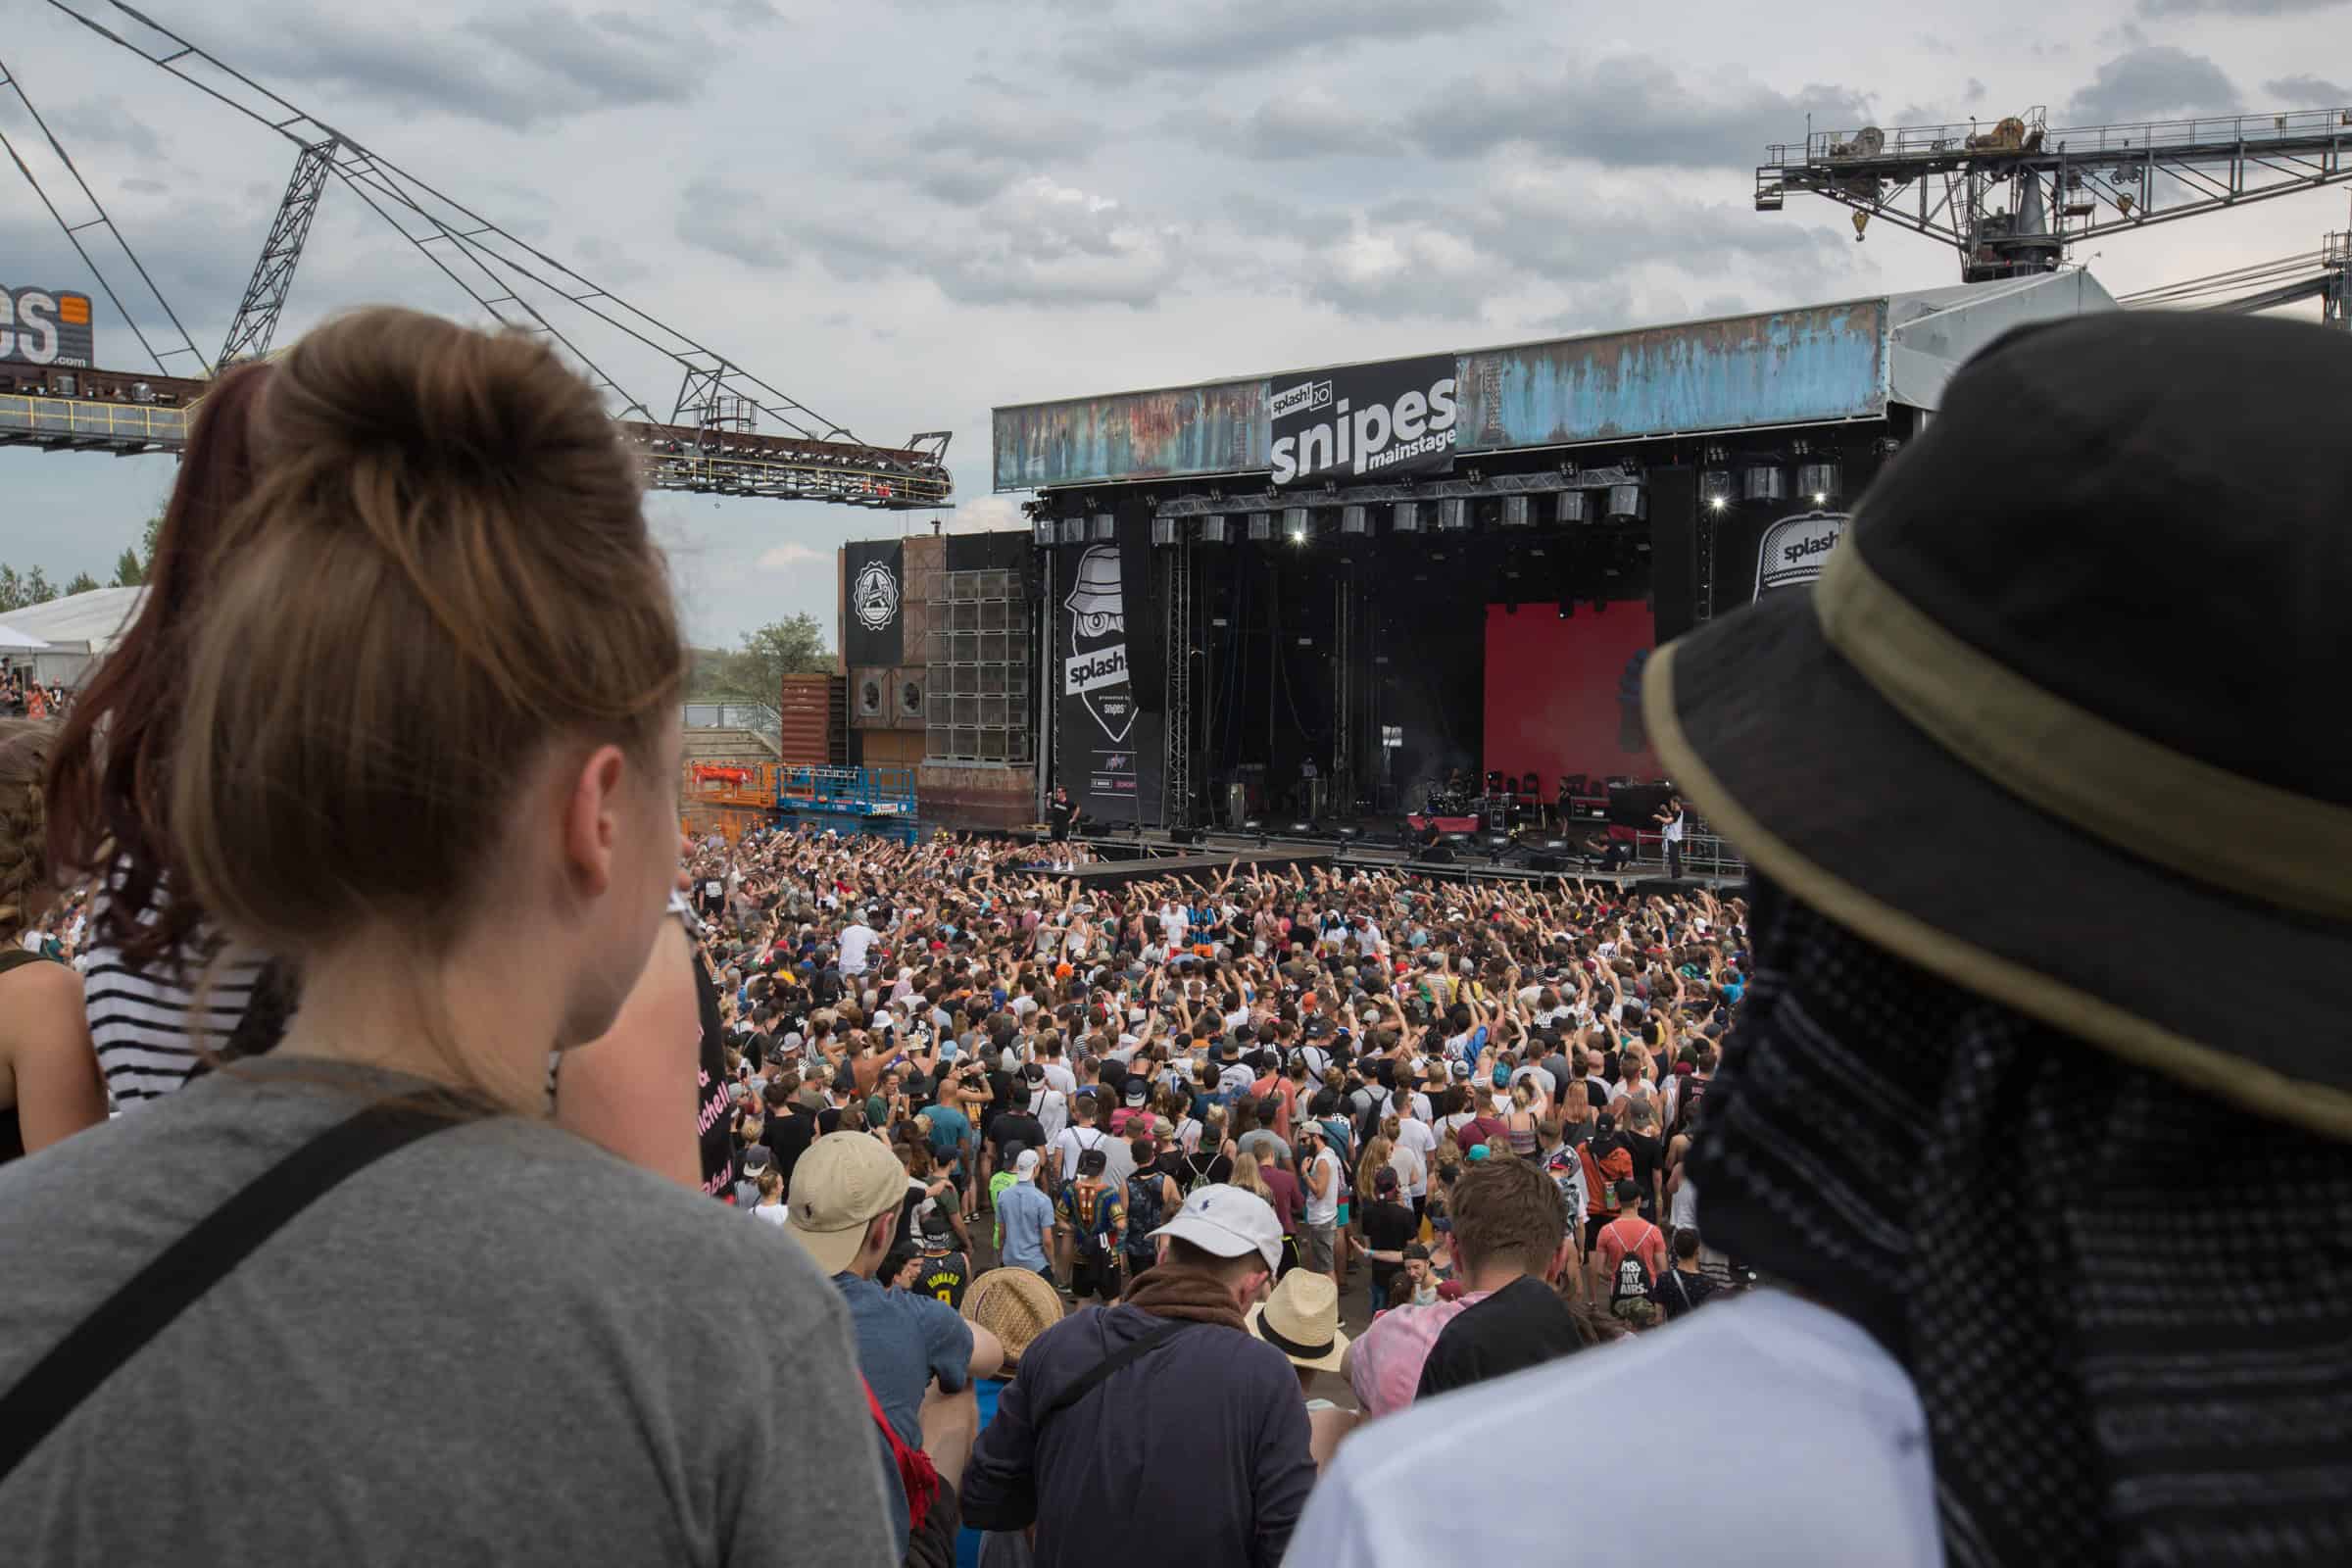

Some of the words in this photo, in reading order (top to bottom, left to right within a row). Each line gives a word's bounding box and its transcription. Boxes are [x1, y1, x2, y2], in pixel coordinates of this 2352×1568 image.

[1273, 386, 1310, 415] splash!
[1271, 378, 1457, 484] snipes
[1369, 428, 1456, 471] mainstage
[1622, 1273, 1640, 1284] MY
